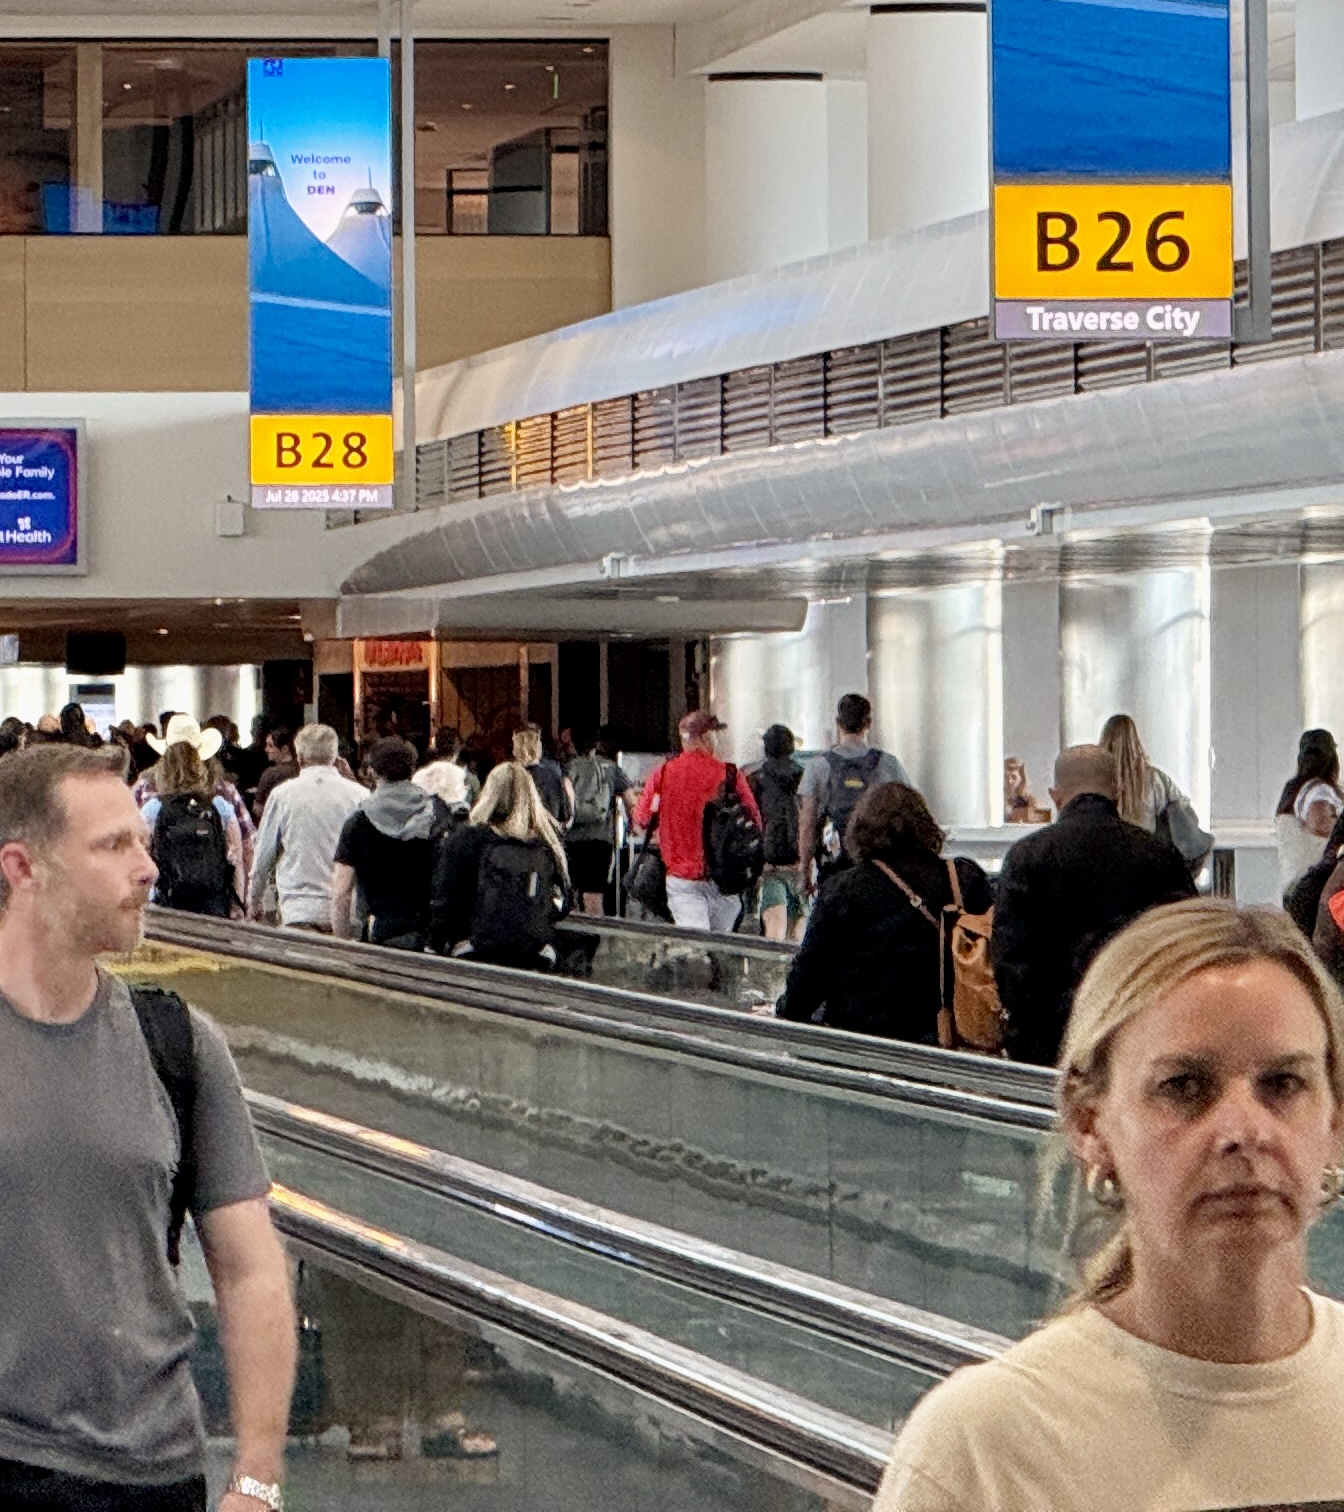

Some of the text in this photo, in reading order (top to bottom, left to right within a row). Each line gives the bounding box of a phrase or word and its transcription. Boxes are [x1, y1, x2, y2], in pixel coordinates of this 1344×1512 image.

[290, 153, 352, 165] Welcome
[313, 169, 327, 180] to
[306, 185, 336, 196] DEN
[1036, 210, 1191, 273] B26
[1025, 304, 1201, 337] Traverse City
[275, 432, 370, 470] B28
[14, 466, 56, 481] Family
[265, 488, 283, 503] Jul
[301, 489, 330, 503] 2025
[358, 489, 379, 503] PM
